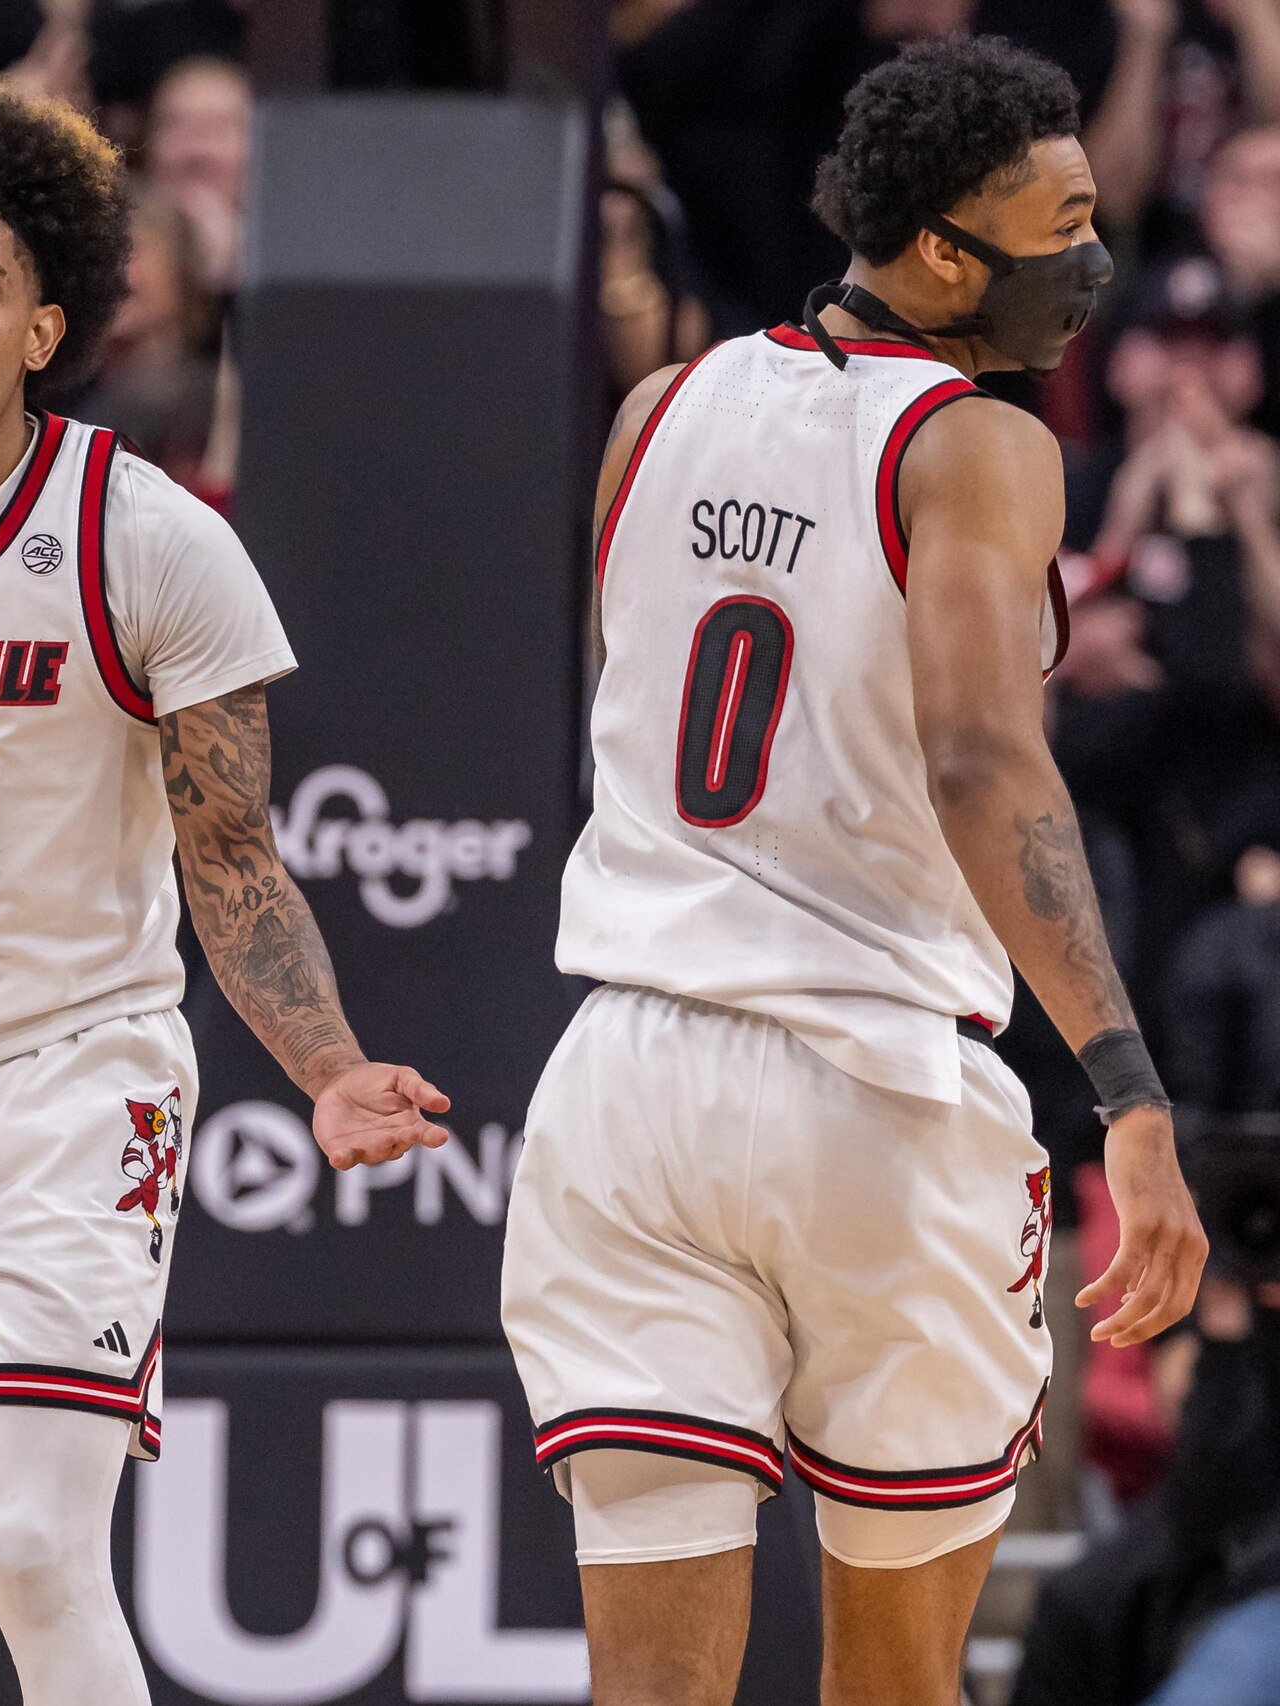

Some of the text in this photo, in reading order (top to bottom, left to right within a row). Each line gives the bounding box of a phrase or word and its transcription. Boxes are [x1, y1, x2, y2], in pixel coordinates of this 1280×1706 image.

[26, 546, 62, 558] ACC
[692, 499, 816, 573] SCOTT
[674, 593, 795, 829] 0
[225, 875, 282, 922] 402
[334, 1122, 525, 1227] PN
[342, 1518, 458, 1586] OF
